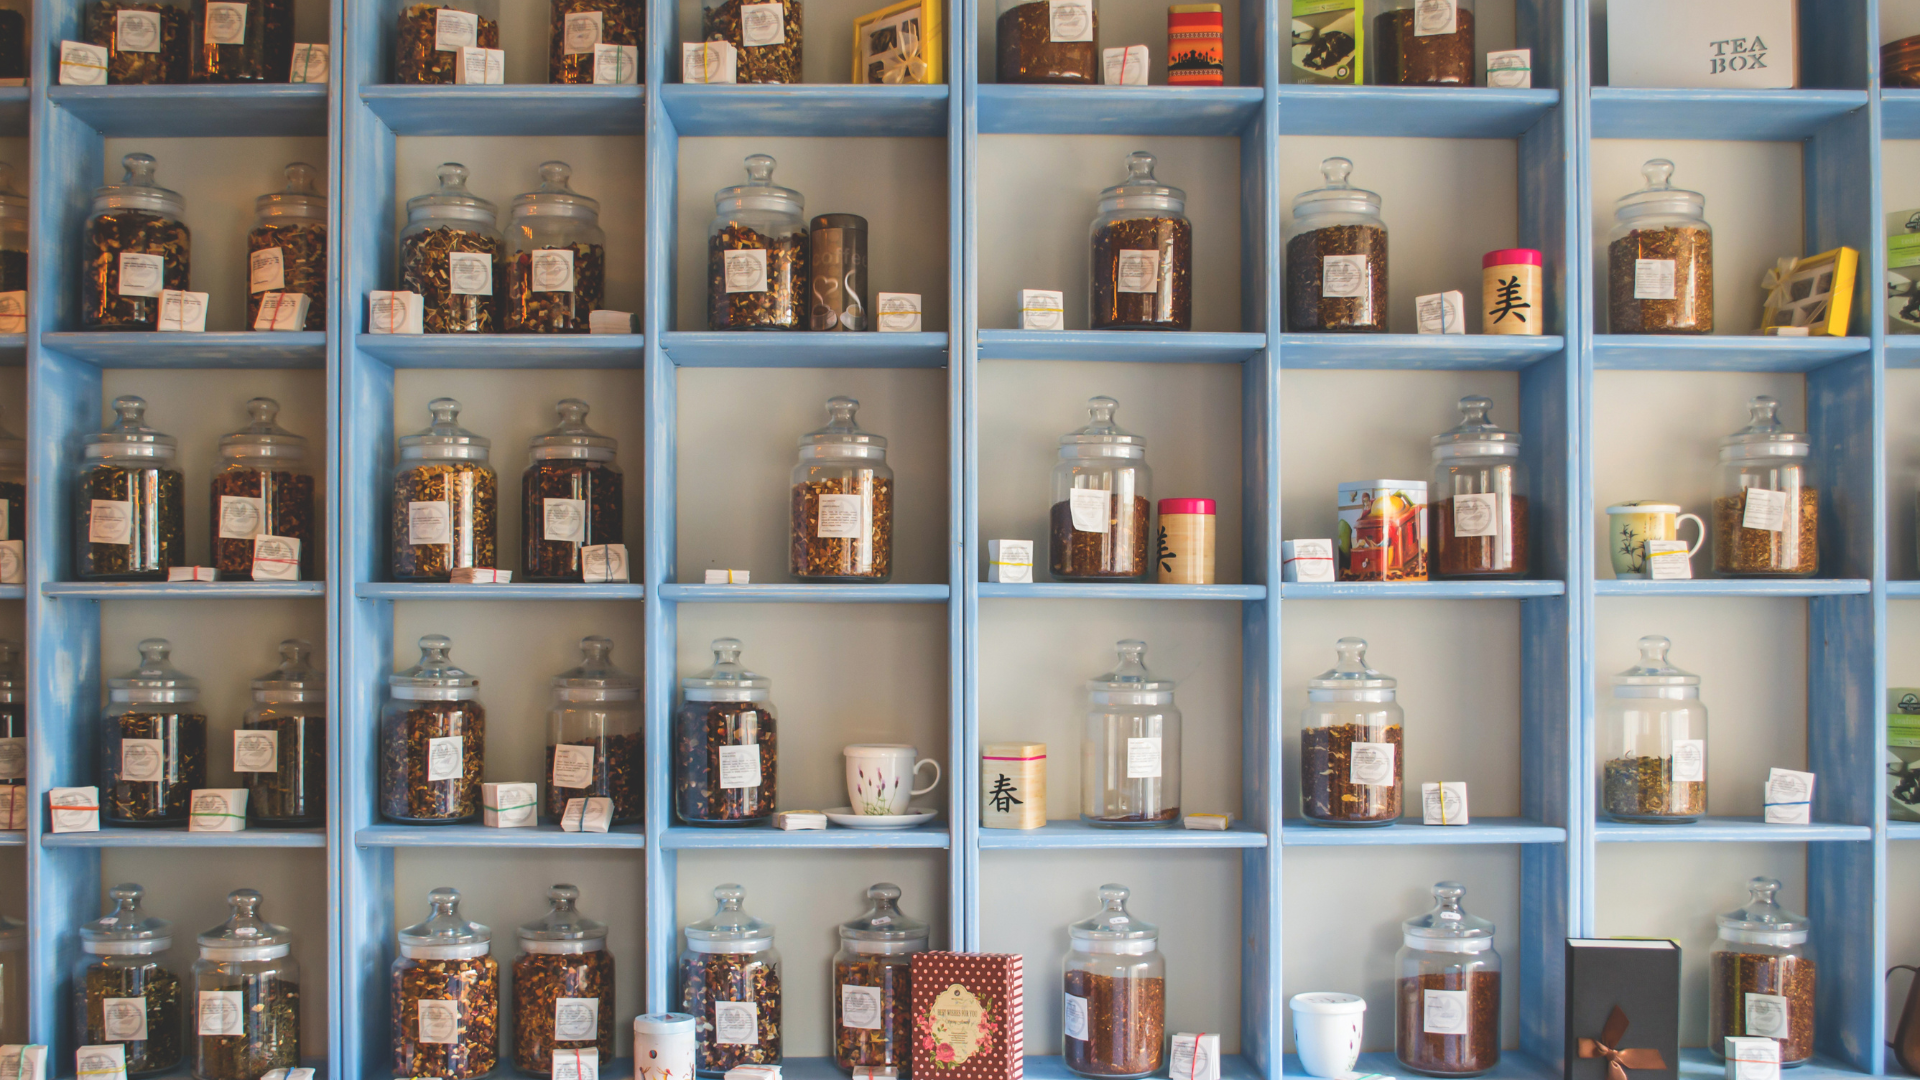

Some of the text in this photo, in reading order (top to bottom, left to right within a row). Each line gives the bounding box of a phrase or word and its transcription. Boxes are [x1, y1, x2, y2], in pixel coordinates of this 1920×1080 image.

[1709, 35, 1768, 57] TEA
[1709, 52, 1768, 75] BOX
[1488, 275, 1532, 325] 美
[988, 772, 1024, 814] 春
